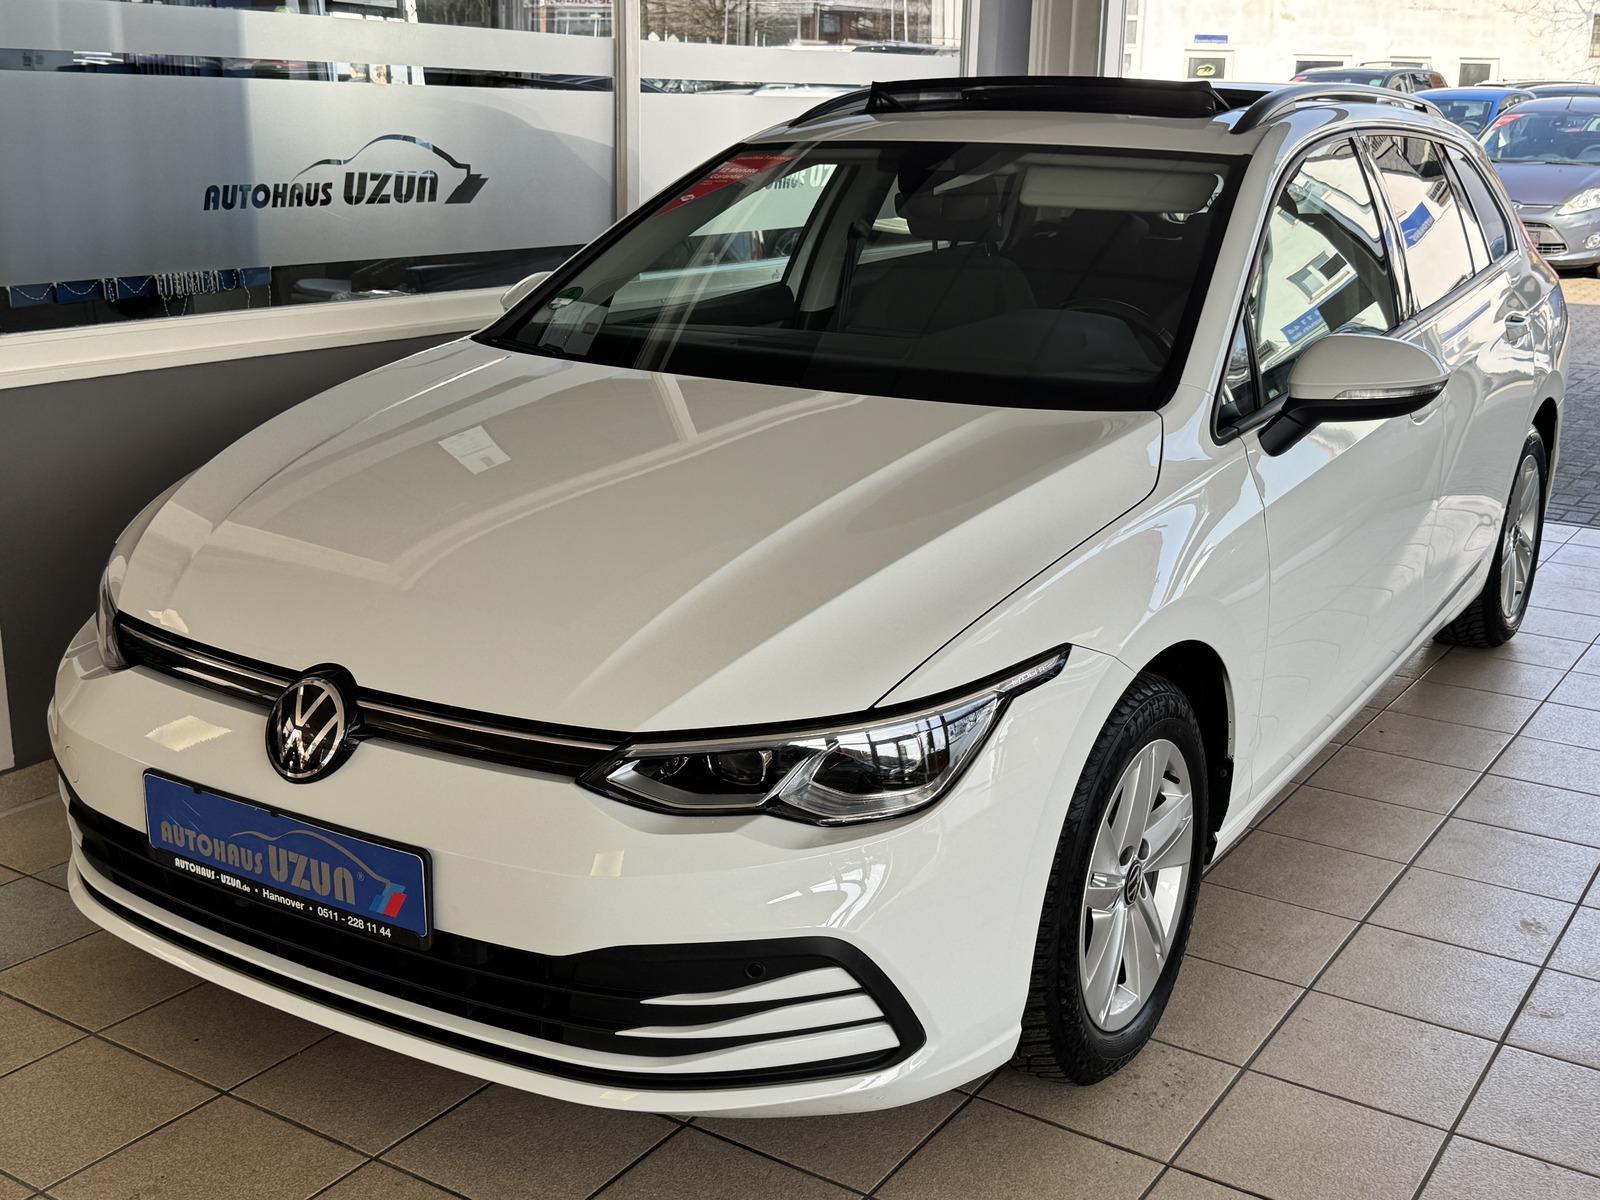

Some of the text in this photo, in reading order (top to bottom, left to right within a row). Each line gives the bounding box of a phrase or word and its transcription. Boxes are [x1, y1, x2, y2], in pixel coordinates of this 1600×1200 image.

[203, 169, 439, 211] AUTOHAUS UZUN
[160, 820, 356, 906] AUTOHAUS UZUN
[262, 888, 305, 910] Hannover
[317, 906, 338, 921] 0511
[347, 915, 365, 930] 228
[366, 922, 377, 934] 11
[379, 926, 392, 939] 44
